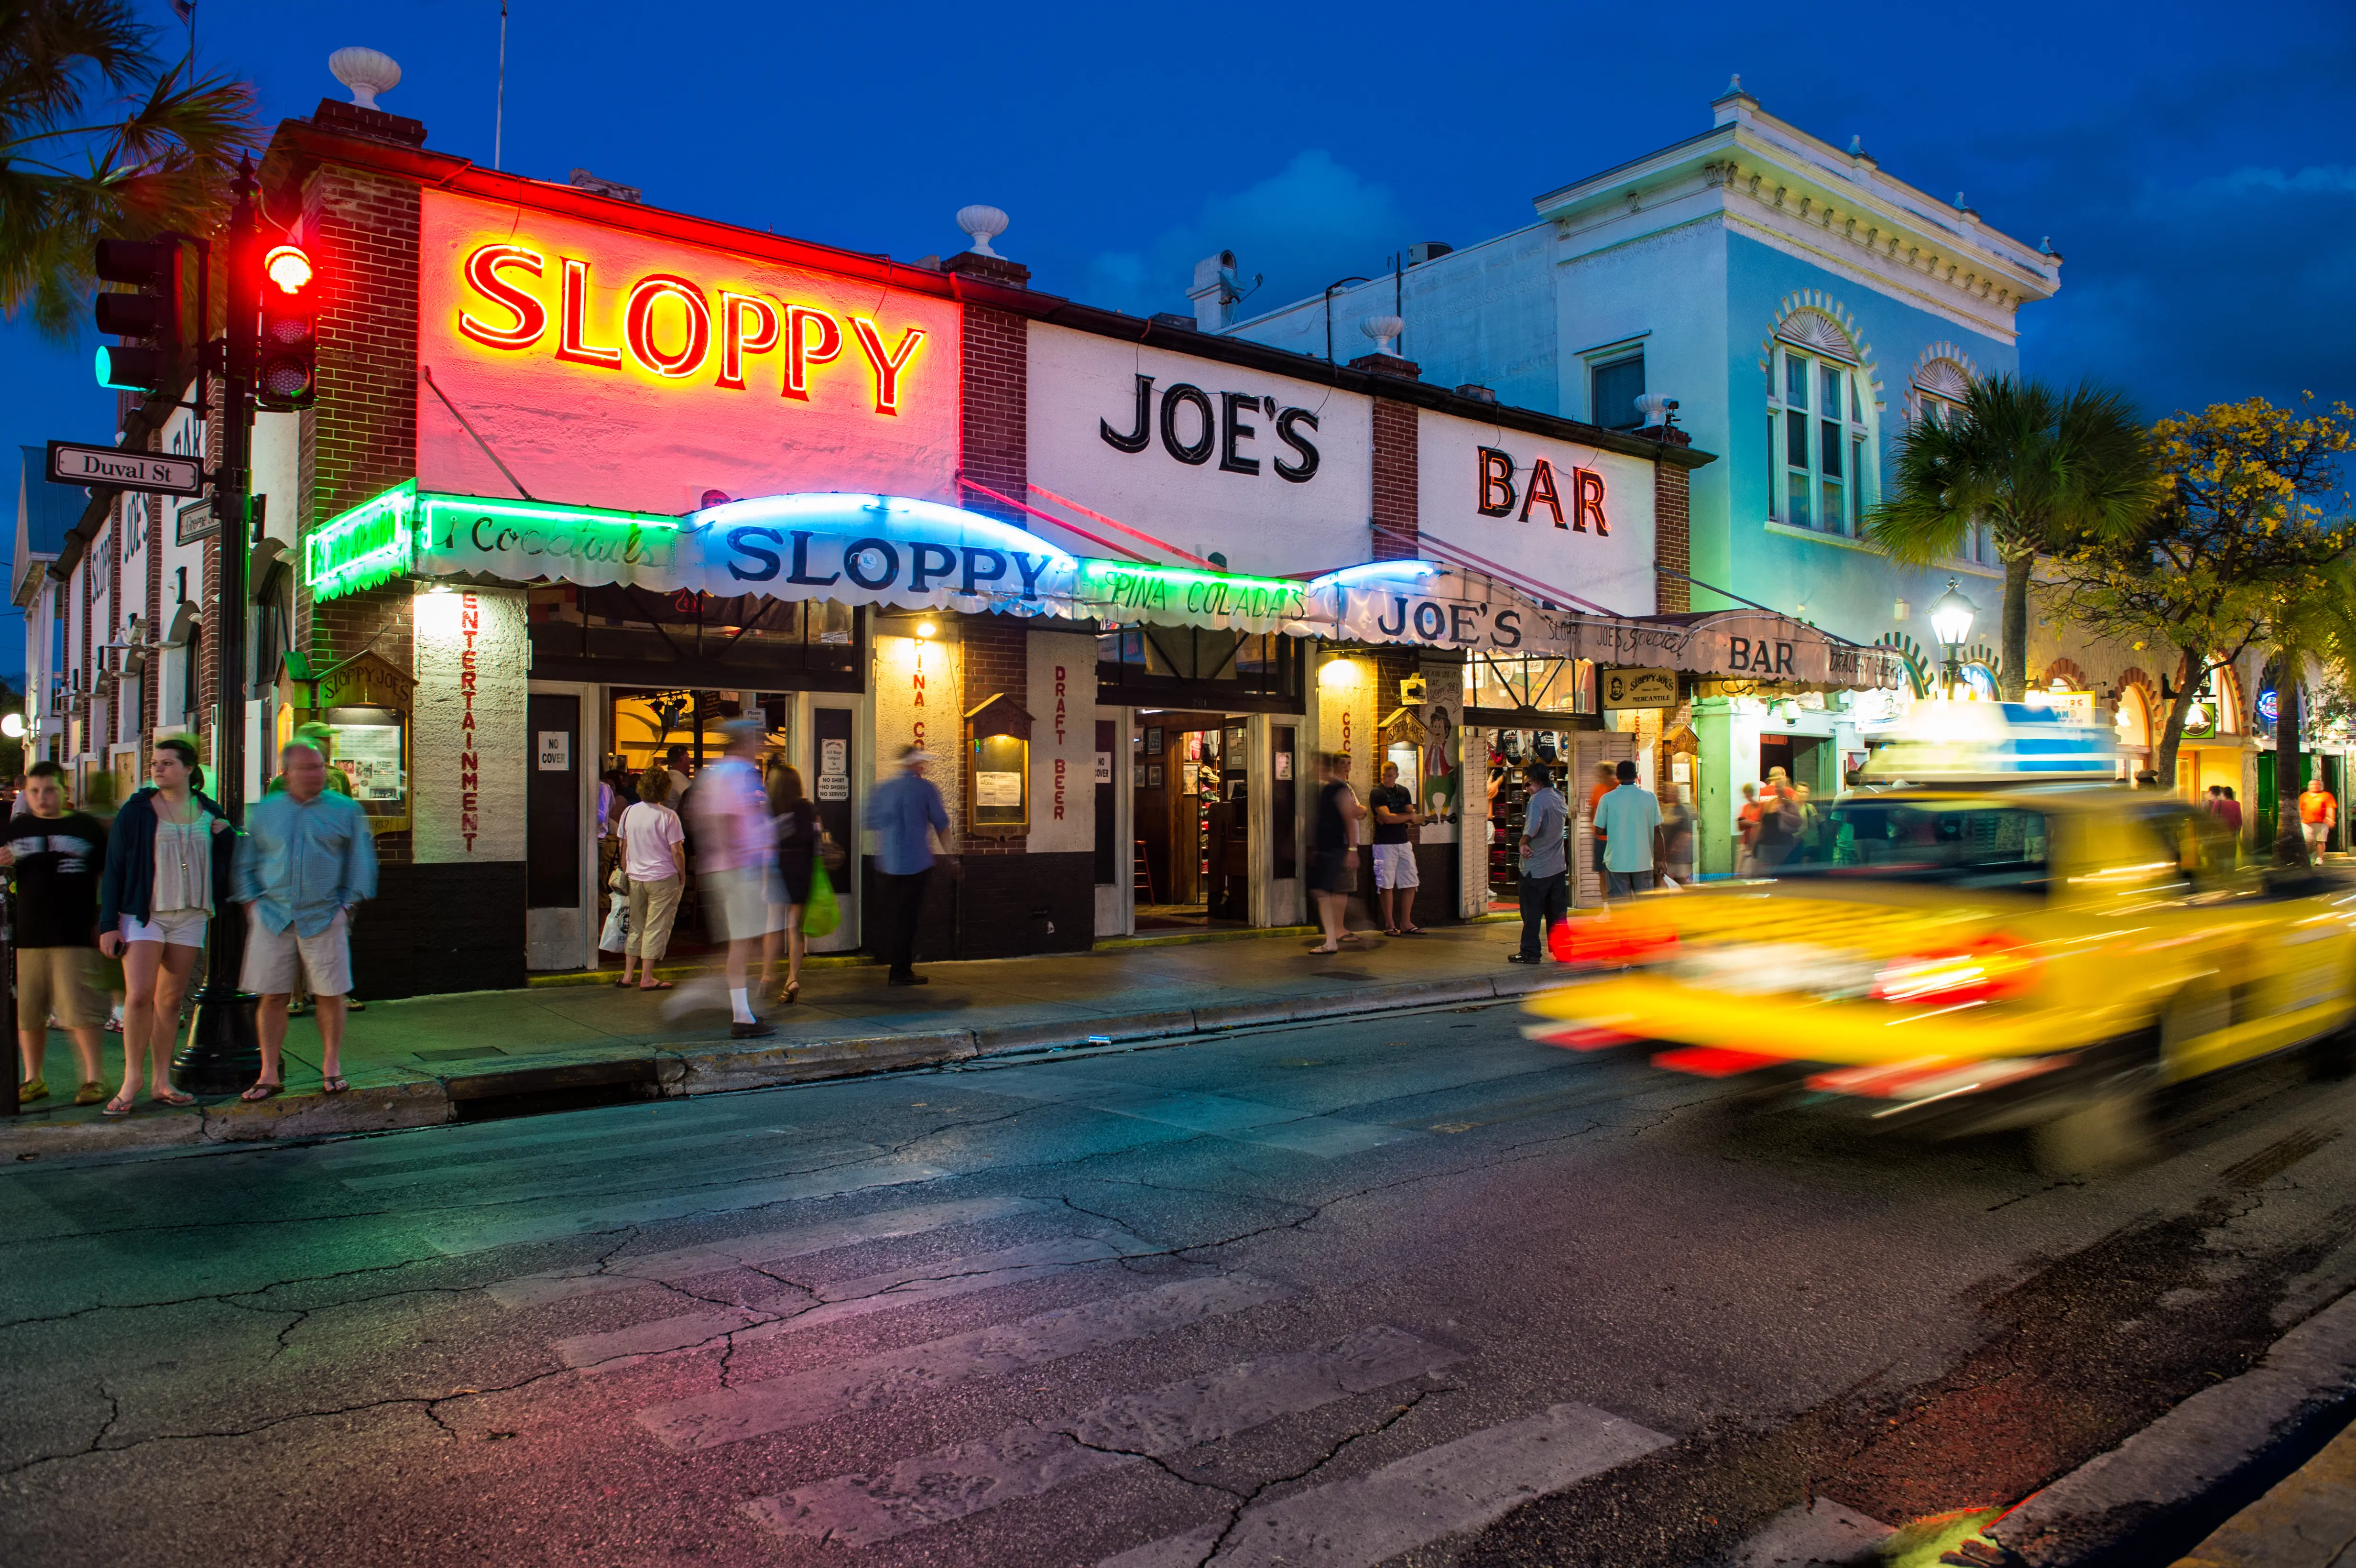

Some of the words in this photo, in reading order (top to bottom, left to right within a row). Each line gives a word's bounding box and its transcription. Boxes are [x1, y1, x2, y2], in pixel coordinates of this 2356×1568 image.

[458, 243, 927, 417] SLOPPY
[1100, 373, 1320, 483] JOE'S
[83, 456, 145, 479] Duval
[152, 464, 172, 482] St
[1476, 445, 1611, 537] BAR
[471, 517, 668, 568] Cocktails
[726, 526, 1053, 602] SLOPPY
[1377, 597, 1521, 648] JOE'S
[1548, 621, 1582, 643] SLOPPY
[1728, 636, 1796, 675] BAR
[325, 666, 375, 698] SLOPPY
[377, 670, 409, 701] JOE'S
[1630, 674, 1656, 691] SLOPPY
[1656, 675, 1673, 691] JOE'S
[461, 590, 478, 852] ENTERTAINMENT
[1055, 666, 1065, 745] DRAFT
[548, 739, 558, 749] NO
[1388, 720, 1409, 740] SLOPPY
[1411, 722, 1424, 743] JOE'S
[542, 753, 566, 764] COVER
[1098, 757, 1105, 766] NO
[1054, 759, 1065, 820] BEER
